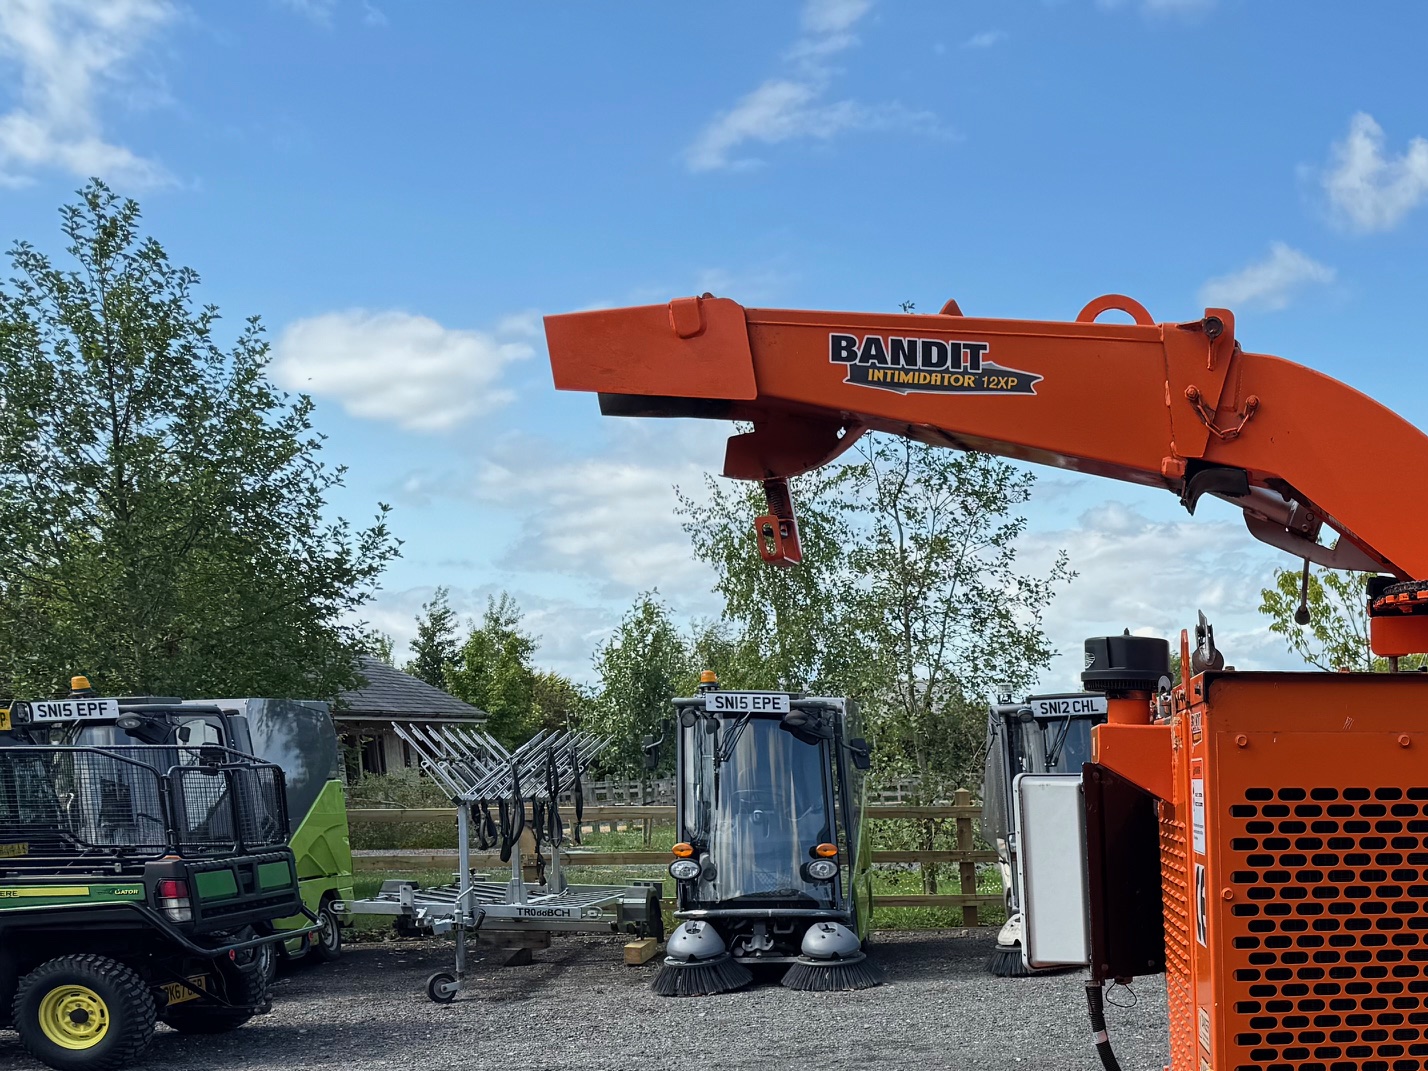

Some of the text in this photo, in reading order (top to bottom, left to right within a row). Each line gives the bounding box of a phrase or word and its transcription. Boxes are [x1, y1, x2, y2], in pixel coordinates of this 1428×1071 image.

[829, 333, 989, 372] BANDIT
[981, 376, 1018, 389] 12XP
[37, 702, 108, 717] SN15 EPF
[715, 696, 781, 710] SN15 EPE
[1040, 699, 1099, 714] SN12 CHL
